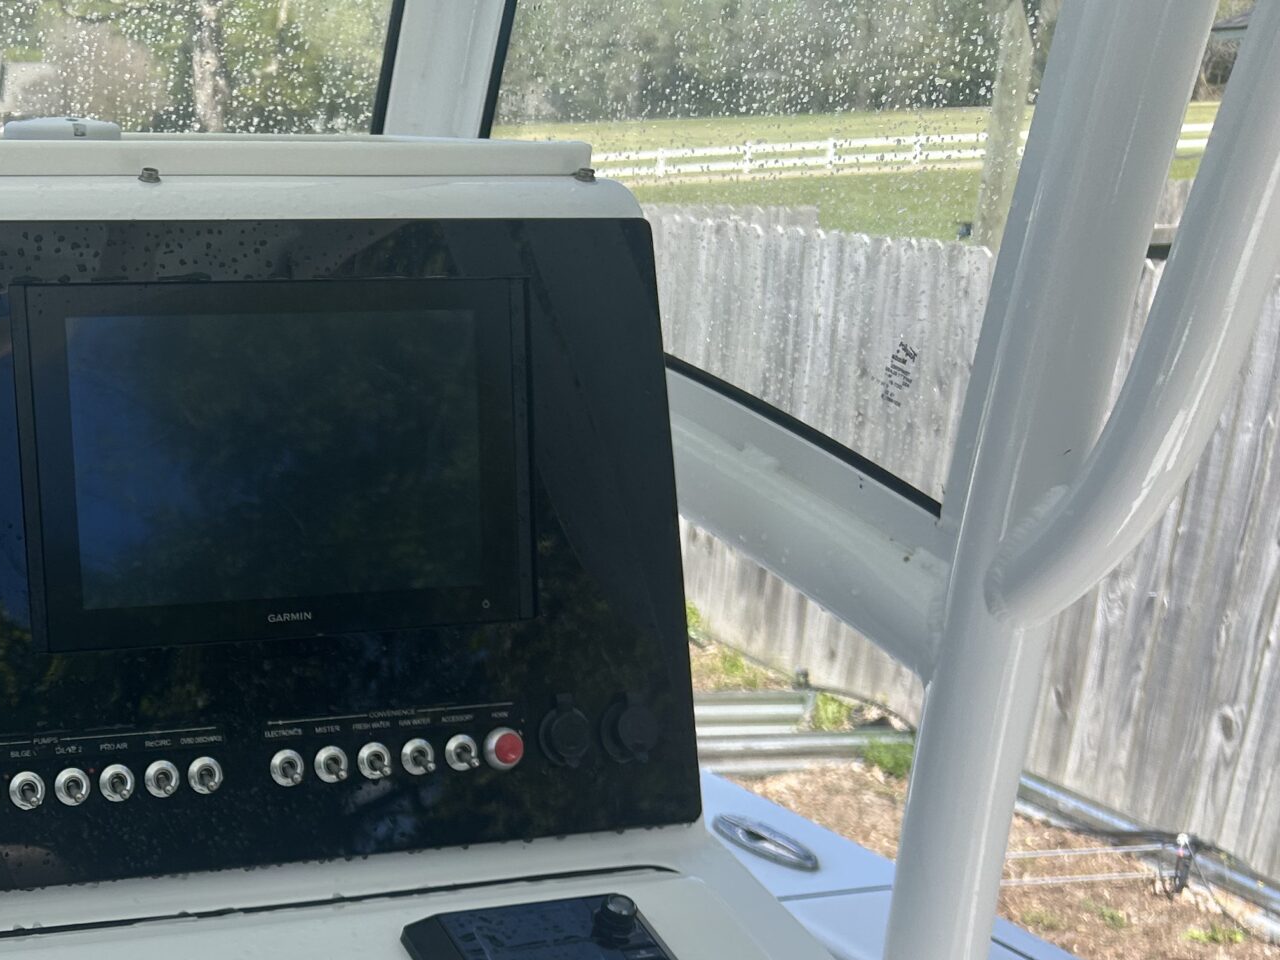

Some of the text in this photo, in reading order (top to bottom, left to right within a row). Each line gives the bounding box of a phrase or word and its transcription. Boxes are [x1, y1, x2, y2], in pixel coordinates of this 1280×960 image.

[267, 611, 312, 623] GARMIN
[368, 708, 416, 719] CONVENIENCE
[315, 725, 341, 734] MISTER
[352, 719, 391, 730] FRESH WATER
[264, 727, 303, 738] ELECTRONICS
[33, 736, 59, 745] PUMPS
[144, 738, 172, 748] RECIRC
[100, 742, 129, 752] PRO AIR
